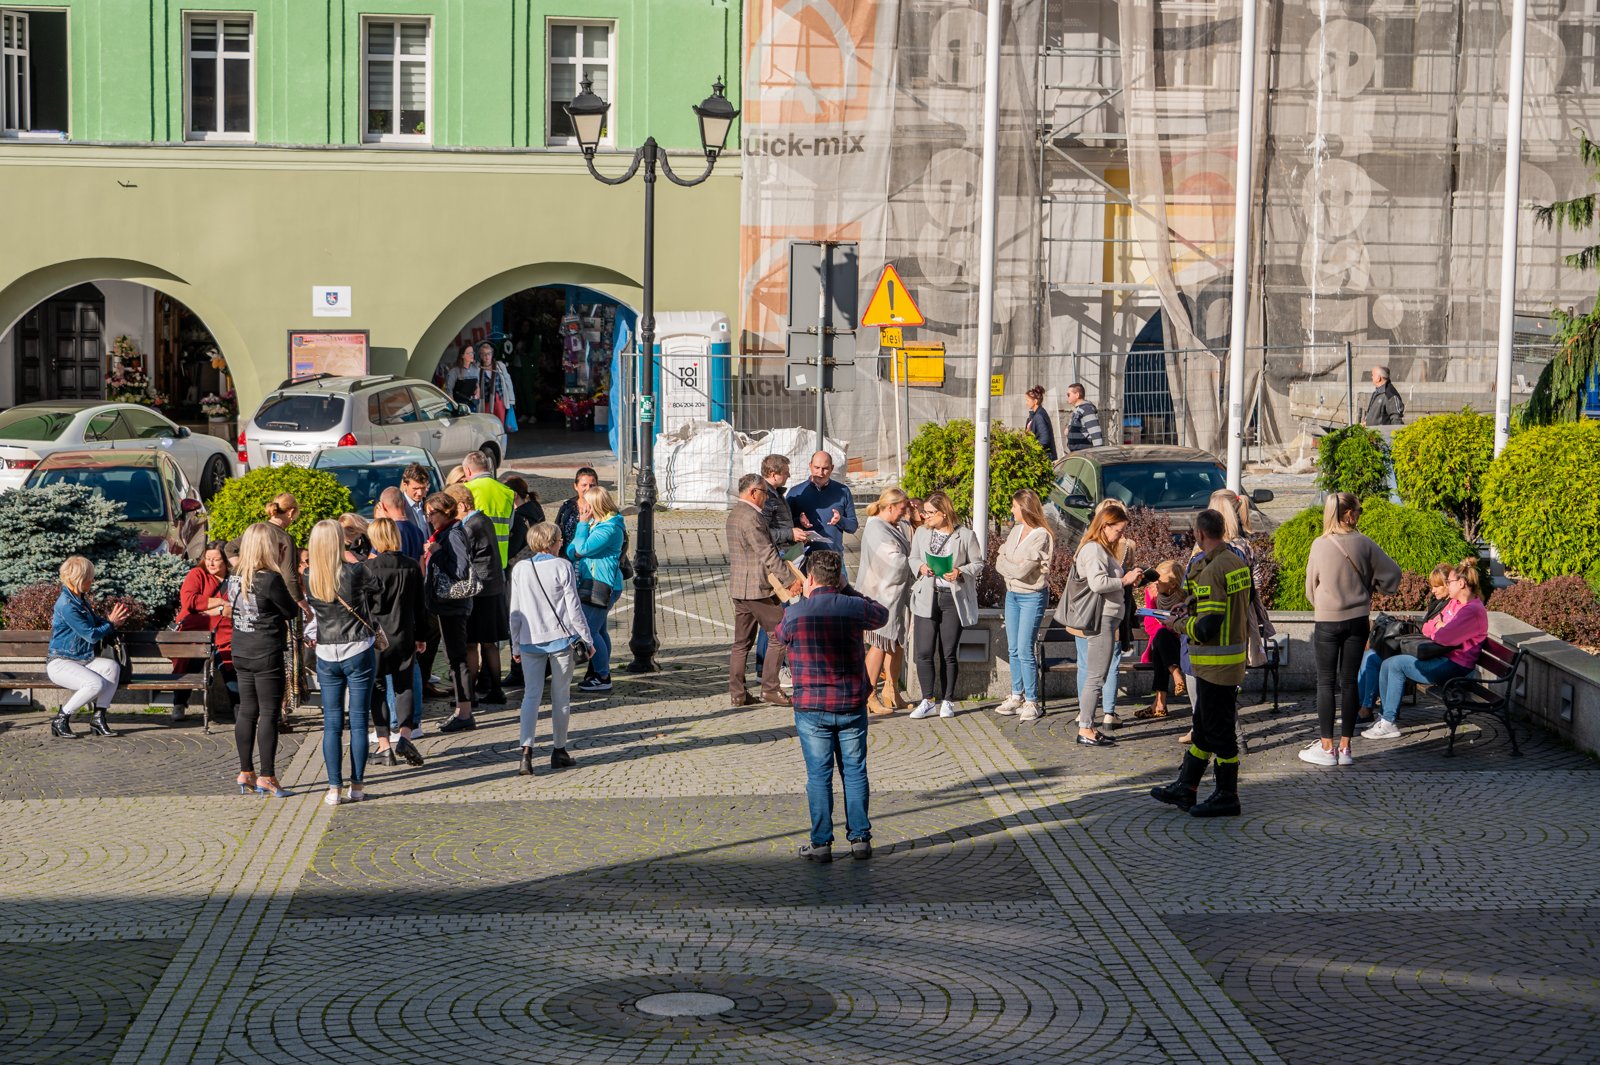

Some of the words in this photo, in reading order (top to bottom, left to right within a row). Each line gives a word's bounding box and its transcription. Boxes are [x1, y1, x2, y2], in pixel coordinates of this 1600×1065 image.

[744, 131, 865, 157] uick-mix
[679, 366, 697, 377] TOI
[680, 377, 697, 387] TOI
[289, 453, 310, 462] 06803
